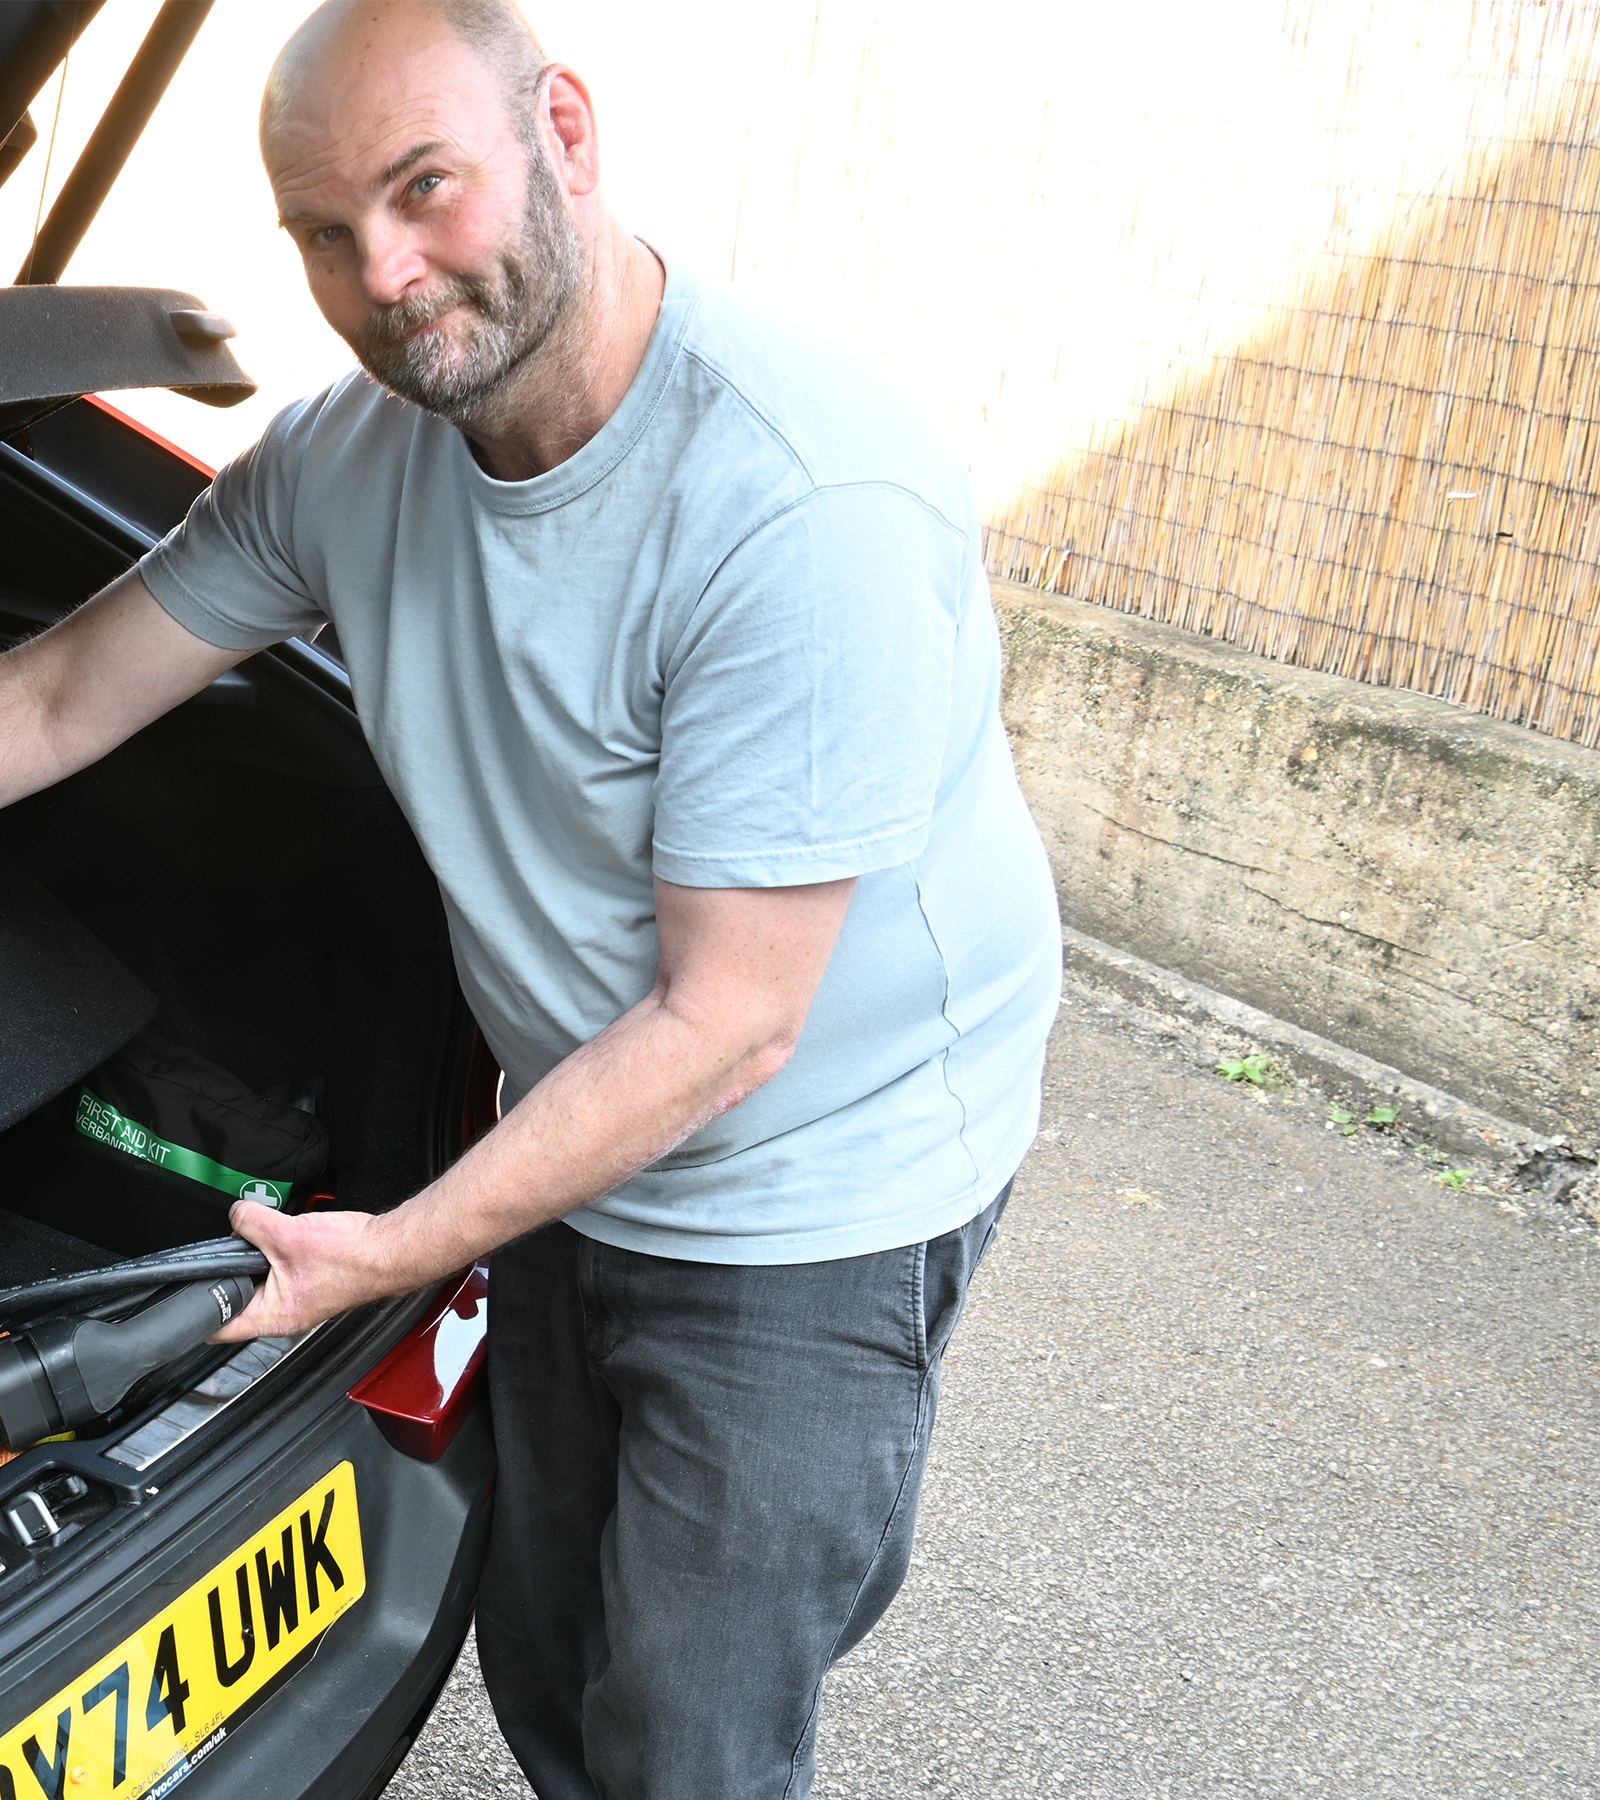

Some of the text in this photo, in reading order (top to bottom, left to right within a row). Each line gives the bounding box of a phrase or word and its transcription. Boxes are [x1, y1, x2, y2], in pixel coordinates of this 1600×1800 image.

[76, 1110, 154, 1164] VERBANDTA
[79, 1094, 171, 1164] FIRST AID KIT
[207, 1488, 345, 1688] UWK
[131, 1781, 146, 1799] Car
[147, 1766, 161, 1785] UK
[161, 1742, 189, 1772] Limited
[194, 1723, 210, 1741] SL6
[211, 1711, 226, 1727] 4FL
